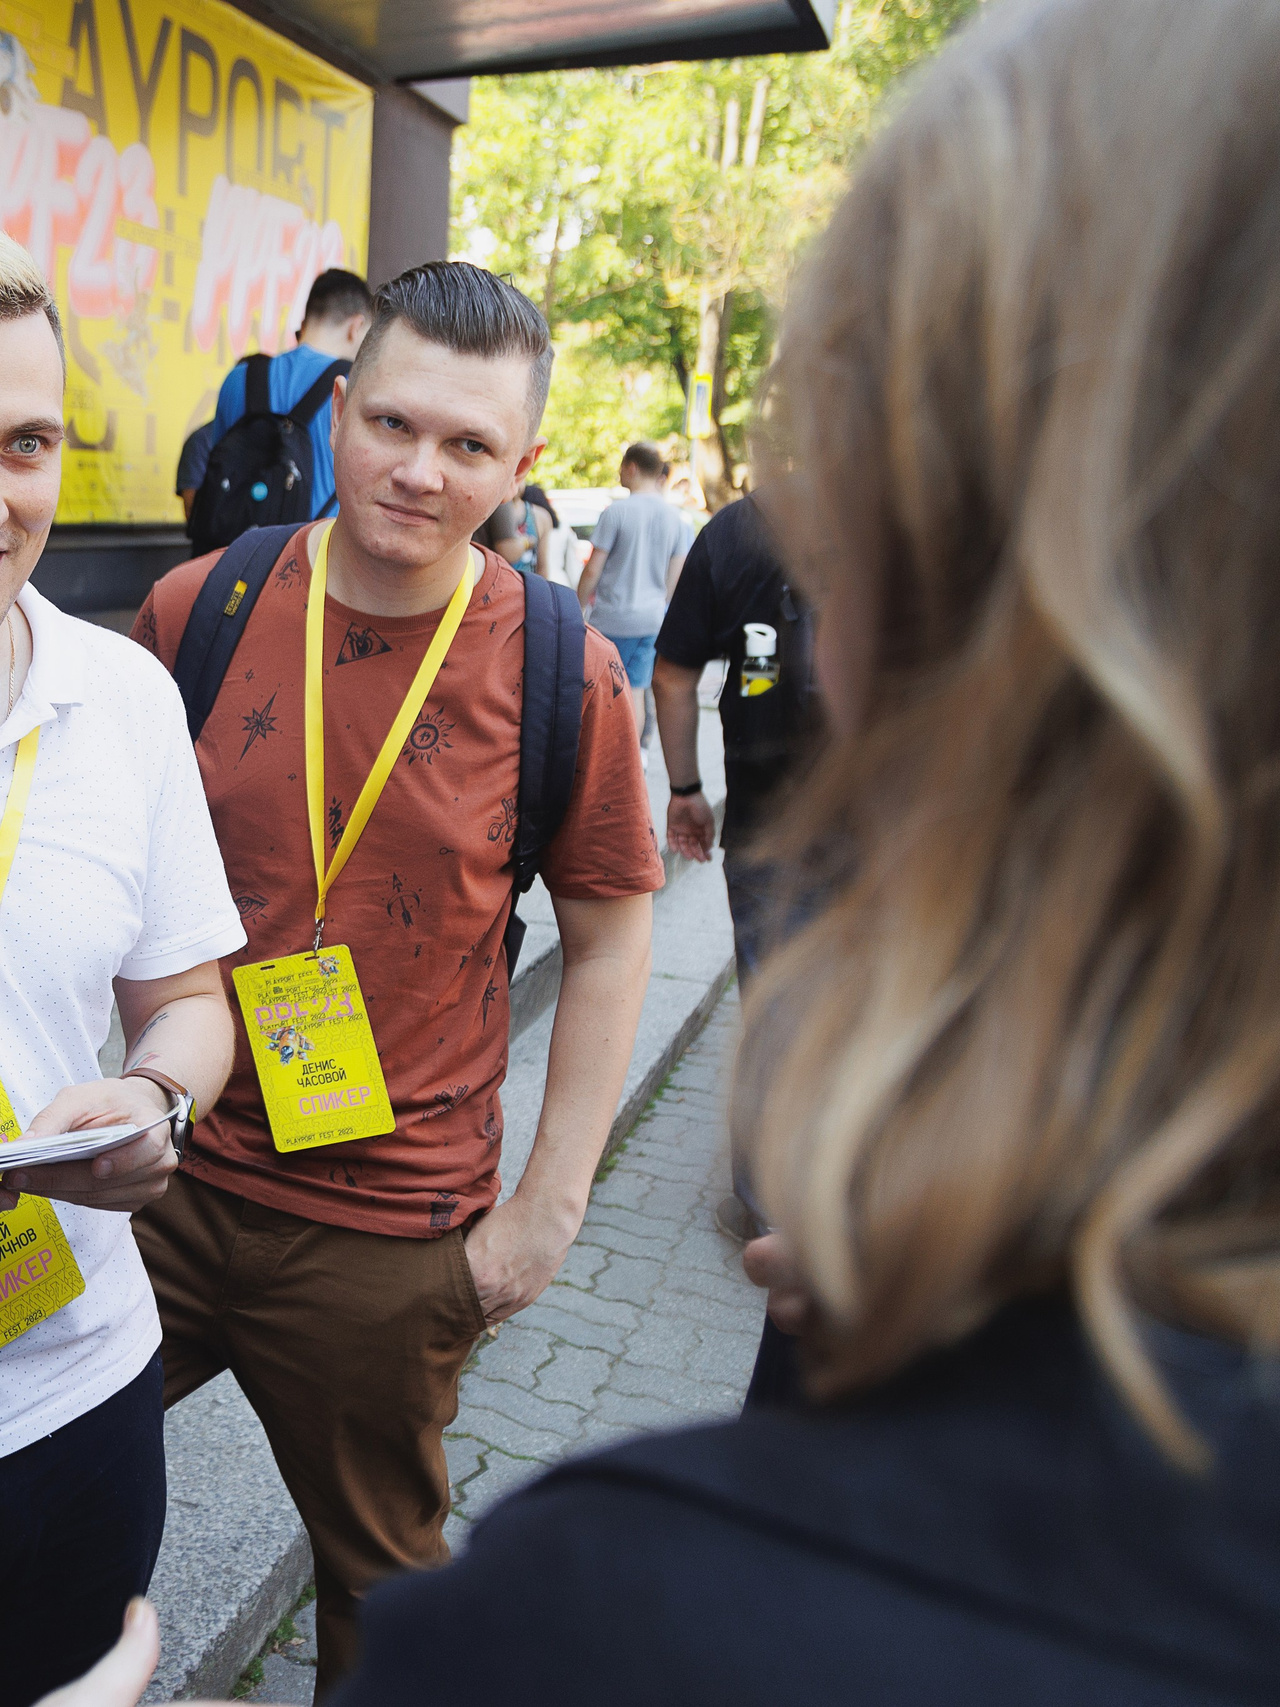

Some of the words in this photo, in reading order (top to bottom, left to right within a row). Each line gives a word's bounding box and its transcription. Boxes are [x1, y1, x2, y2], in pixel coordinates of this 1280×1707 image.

[295, 1020, 325, 1031] PLAYPORT
[348, 1013, 363, 1021] 2023
[302, 1059, 337, 1076] ДЕНИС
[297, 1068, 347, 1088] ЧАСОВОЙ
[299, 1086, 371, 1115] СПИКЕР
[285, 1134, 315, 1145] PLAYPORT
[319, 1130, 334, 1139] FEST
[337, 1127, 353, 1135] 2023
[2, 1322, 23, 1339] FEST
[23, 1309, 44, 1325] 2023
